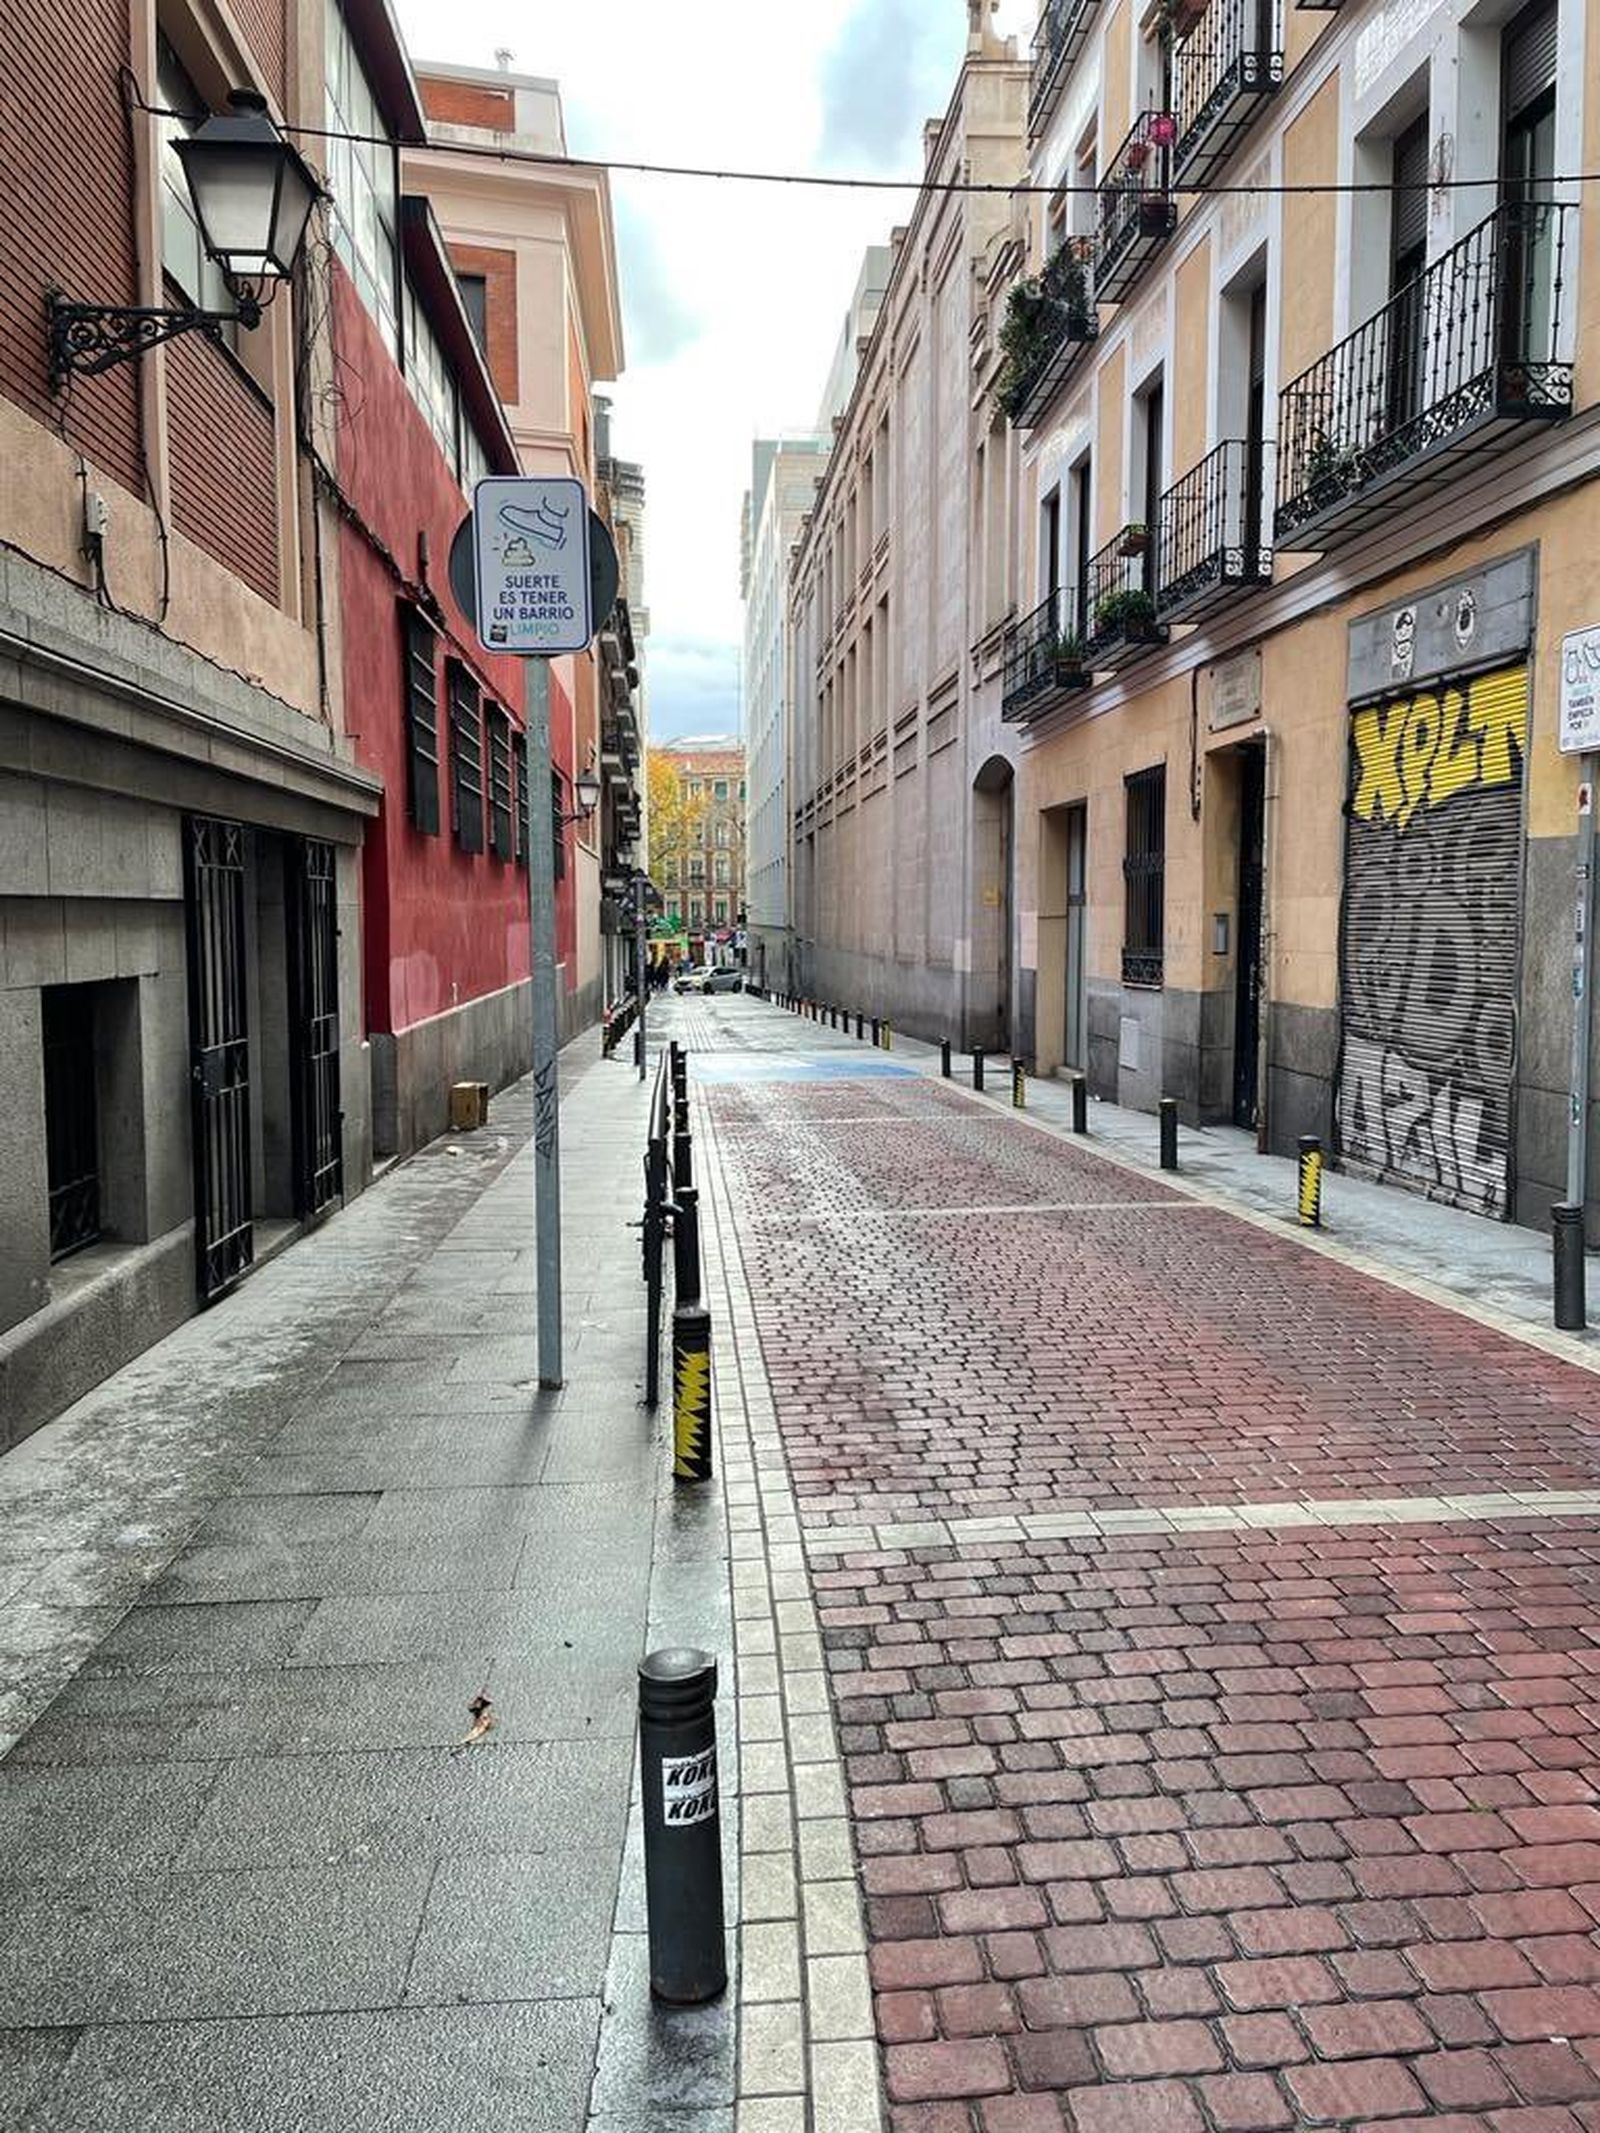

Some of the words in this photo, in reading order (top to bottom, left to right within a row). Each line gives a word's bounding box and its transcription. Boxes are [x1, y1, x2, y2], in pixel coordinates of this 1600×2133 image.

[505, 575, 560, 588] SUERTE
[500, 591, 517, 604] ES
[521, 591, 567, 604] TENER
[493, 607, 514, 620] UN
[519, 607, 574, 620] BARRIO
[511, 623, 559, 635] LIMPIO
